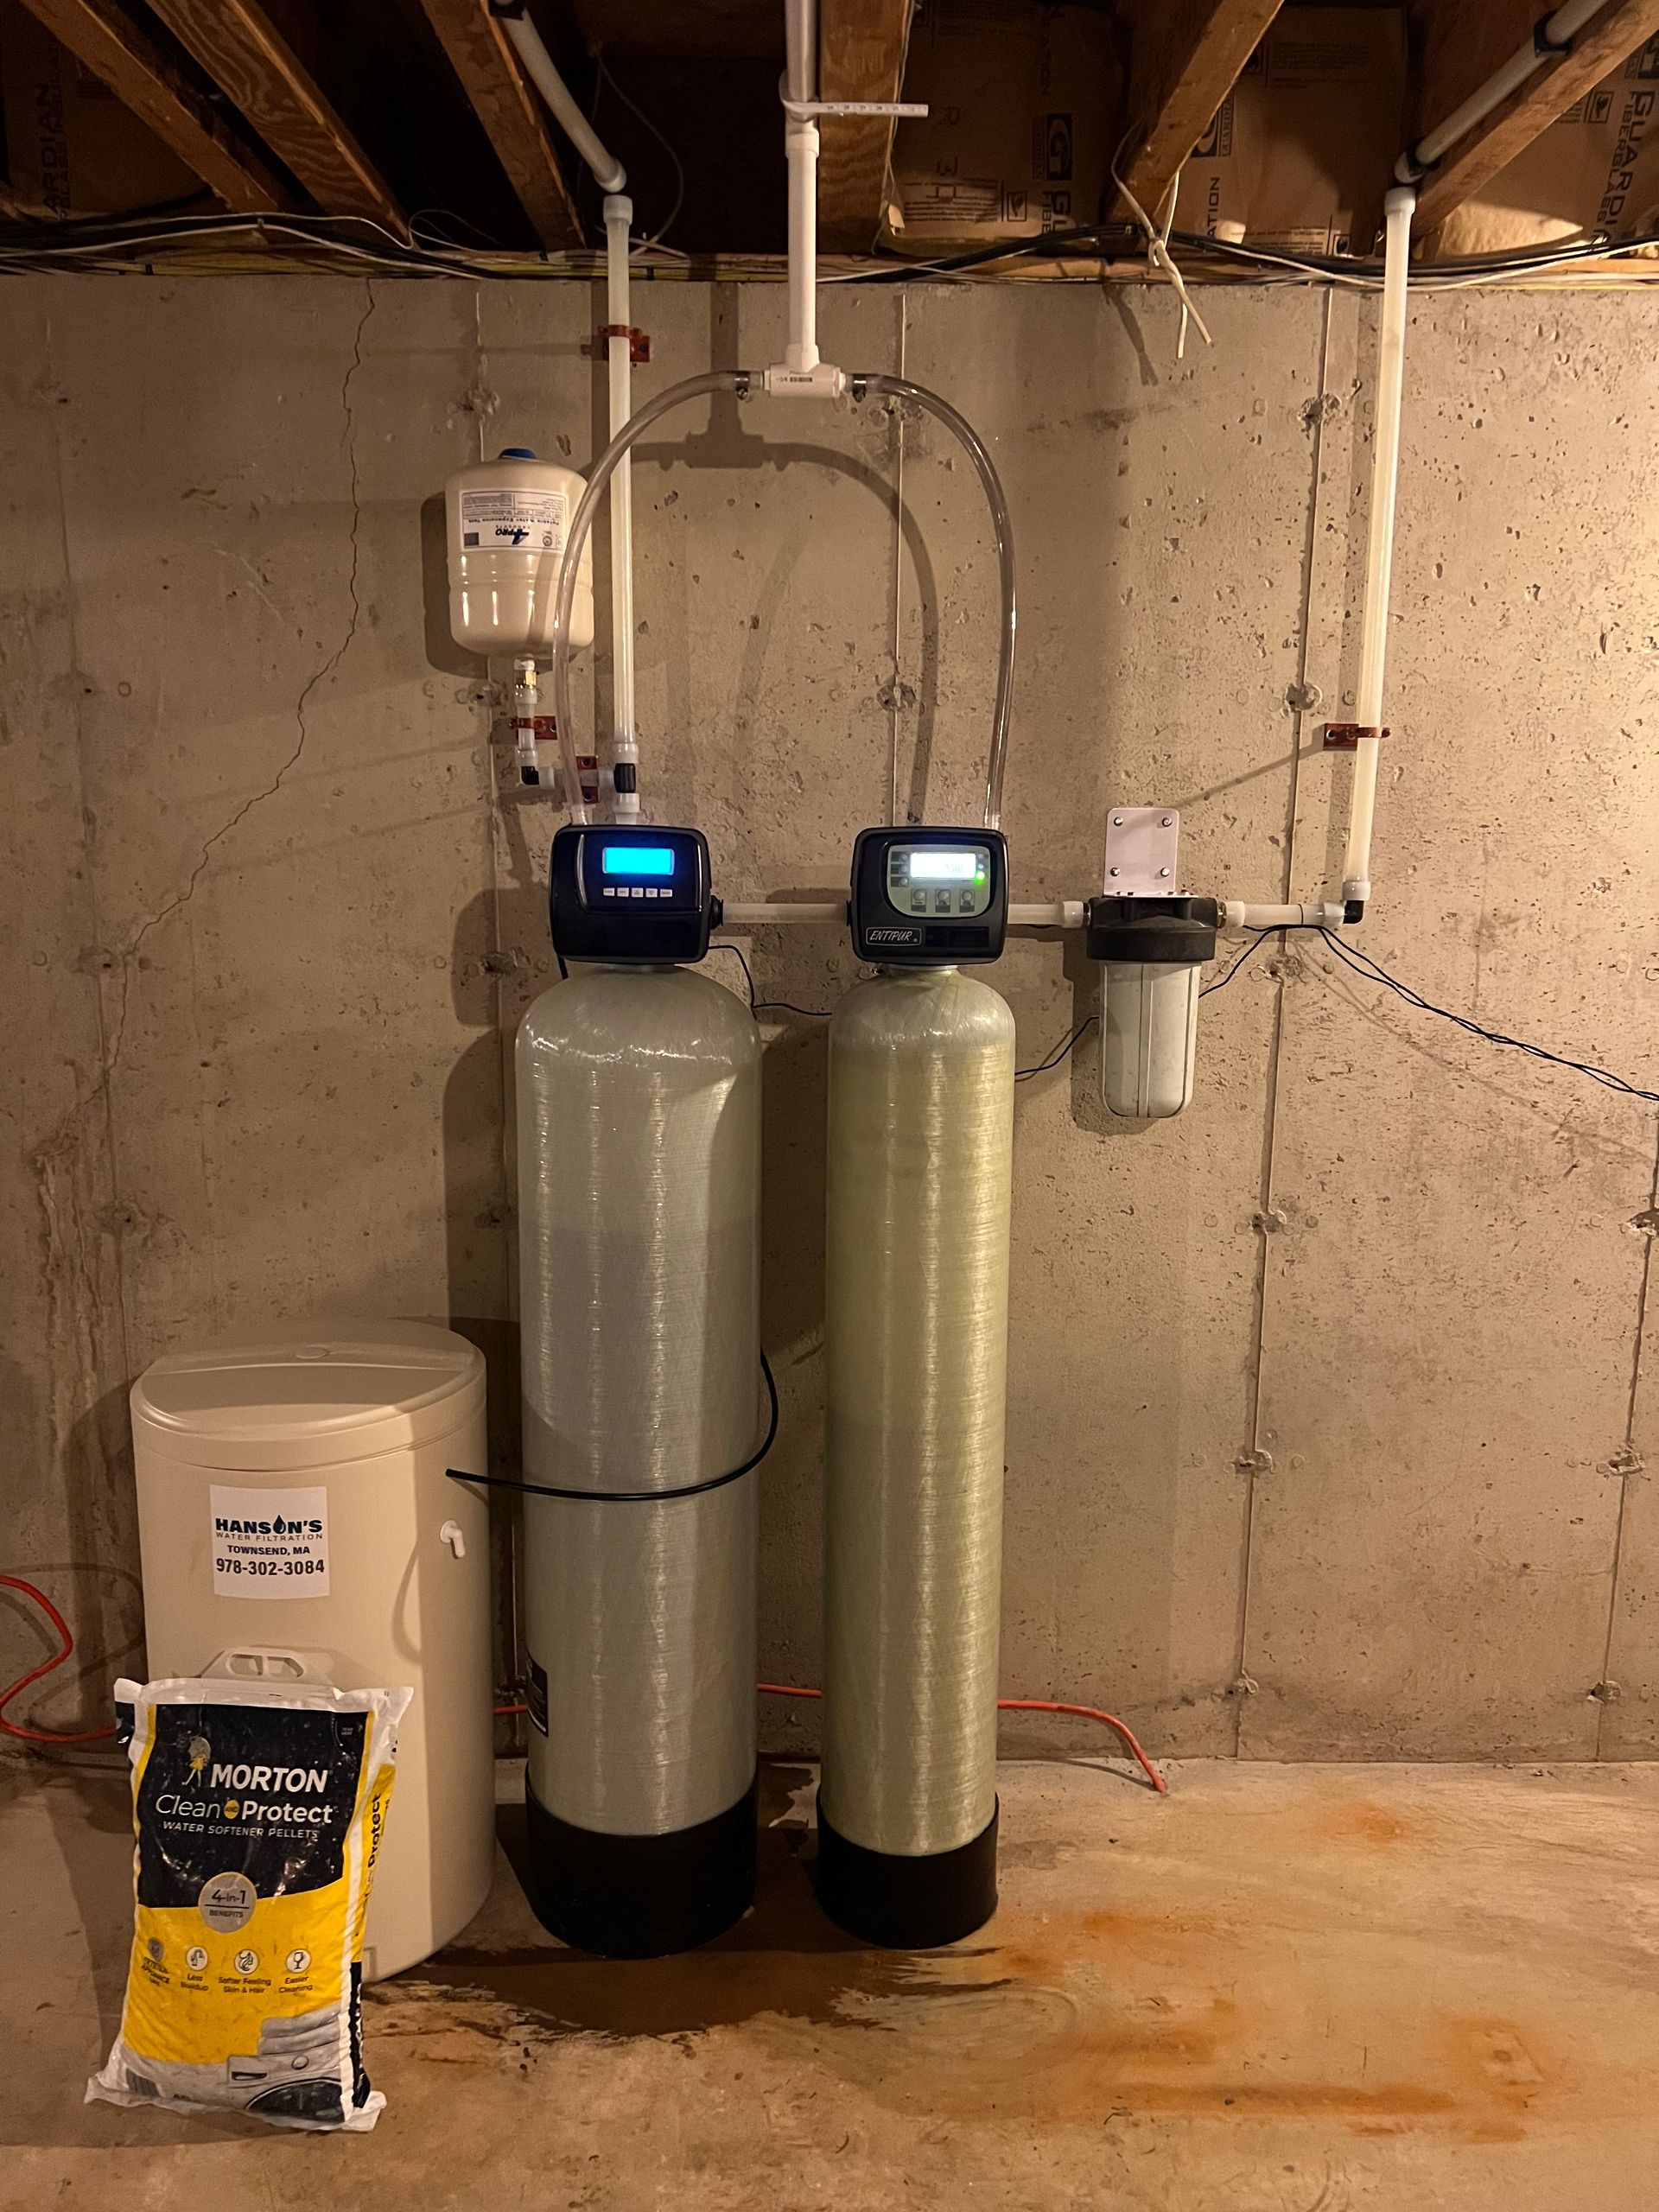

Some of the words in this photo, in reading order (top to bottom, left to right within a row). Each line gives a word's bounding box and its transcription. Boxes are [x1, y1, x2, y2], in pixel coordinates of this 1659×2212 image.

[35, 83, 58, 213] ARDIAN
[1207, 176, 1220, 238] ATION
[869, 930, 912, 942] ENTIPUR
[215, 1514, 322, 1535] HANSON'S
[216, 1531, 251, 1541] WATER
[256, 1534, 323, 1542] FILTRATION
[227, 1545, 290, 1556] TOWNSEND,
[216, 1558, 325, 1576] 978-302-3084
[210, 1764, 328, 1793] MORTON
[156, 1795, 220, 1819] Clean
[242, 1801, 334, 1824] Protect
[162, 1821, 205, 1833] WATER
[207, 1825, 264, 1837] SOFTENER
[268, 1827, 319, 1839] PELLETS
[367, 1793, 381, 1869] Protect
[212, 1890, 246, 1904] 4-in-1
[243, 1977, 271, 1986] Feeling
